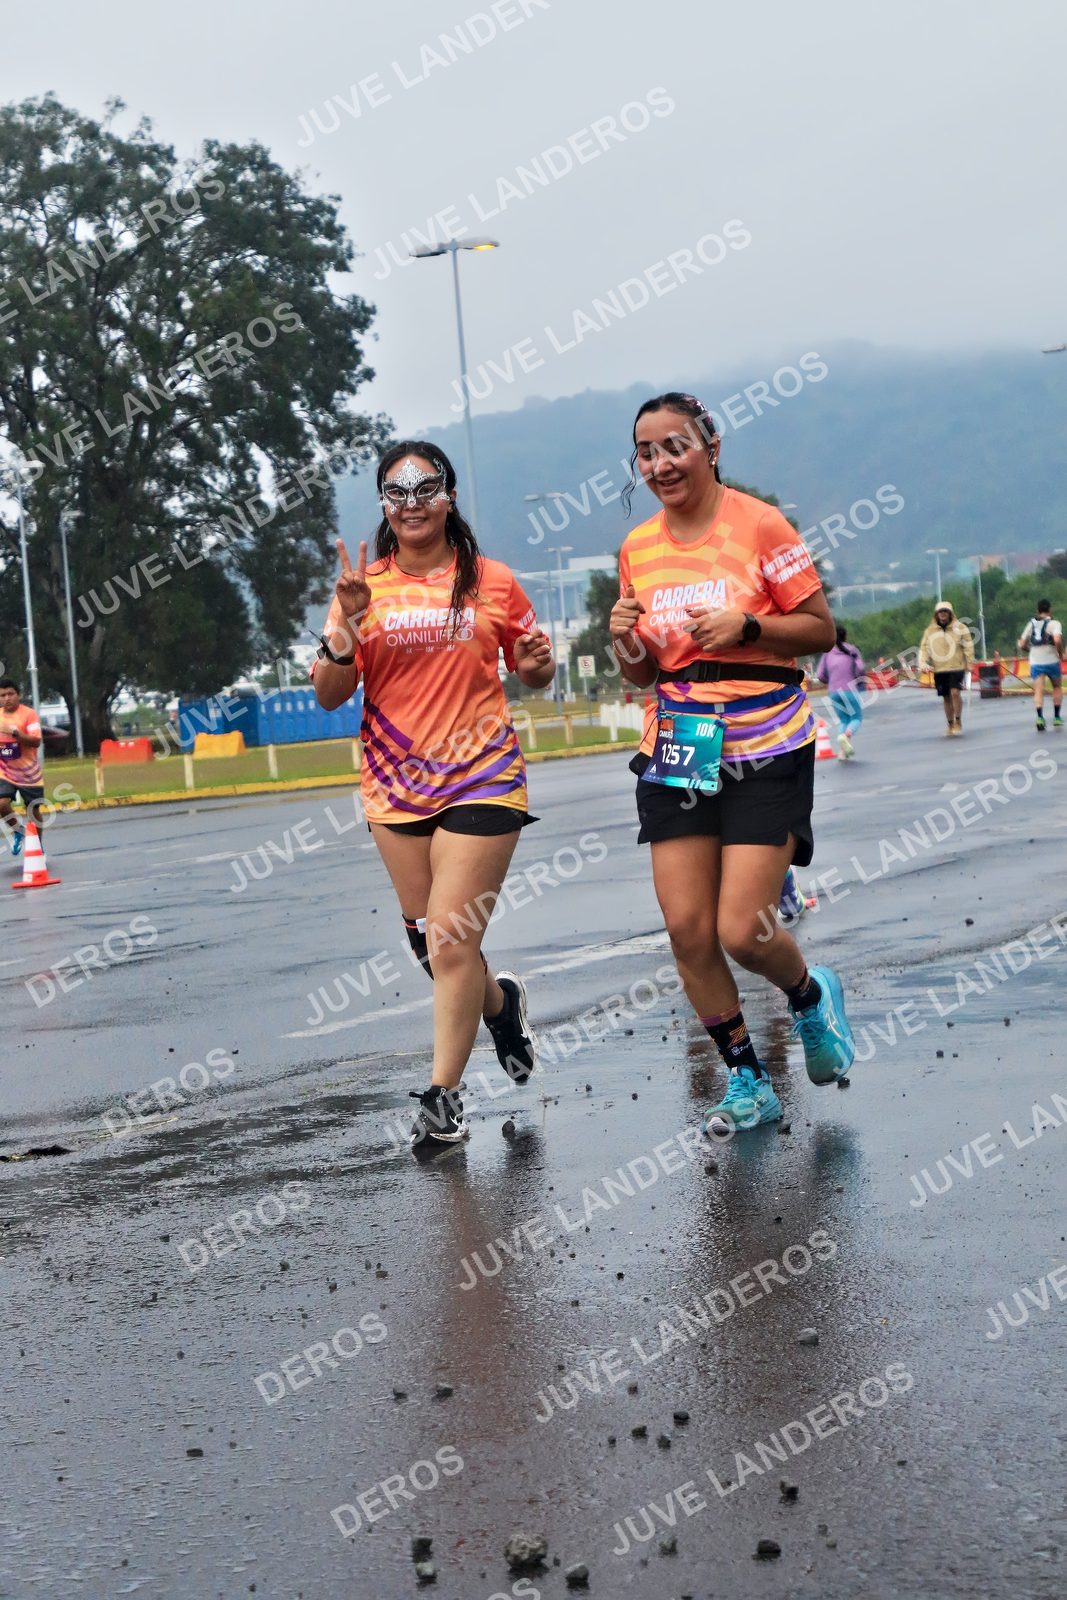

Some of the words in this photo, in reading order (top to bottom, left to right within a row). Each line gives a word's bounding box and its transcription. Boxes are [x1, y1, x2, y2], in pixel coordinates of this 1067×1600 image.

[652, 578, 725, 611] CARRERA
[695, 721, 717, 738] 10K
[661, 743, 696, 767] 1257
